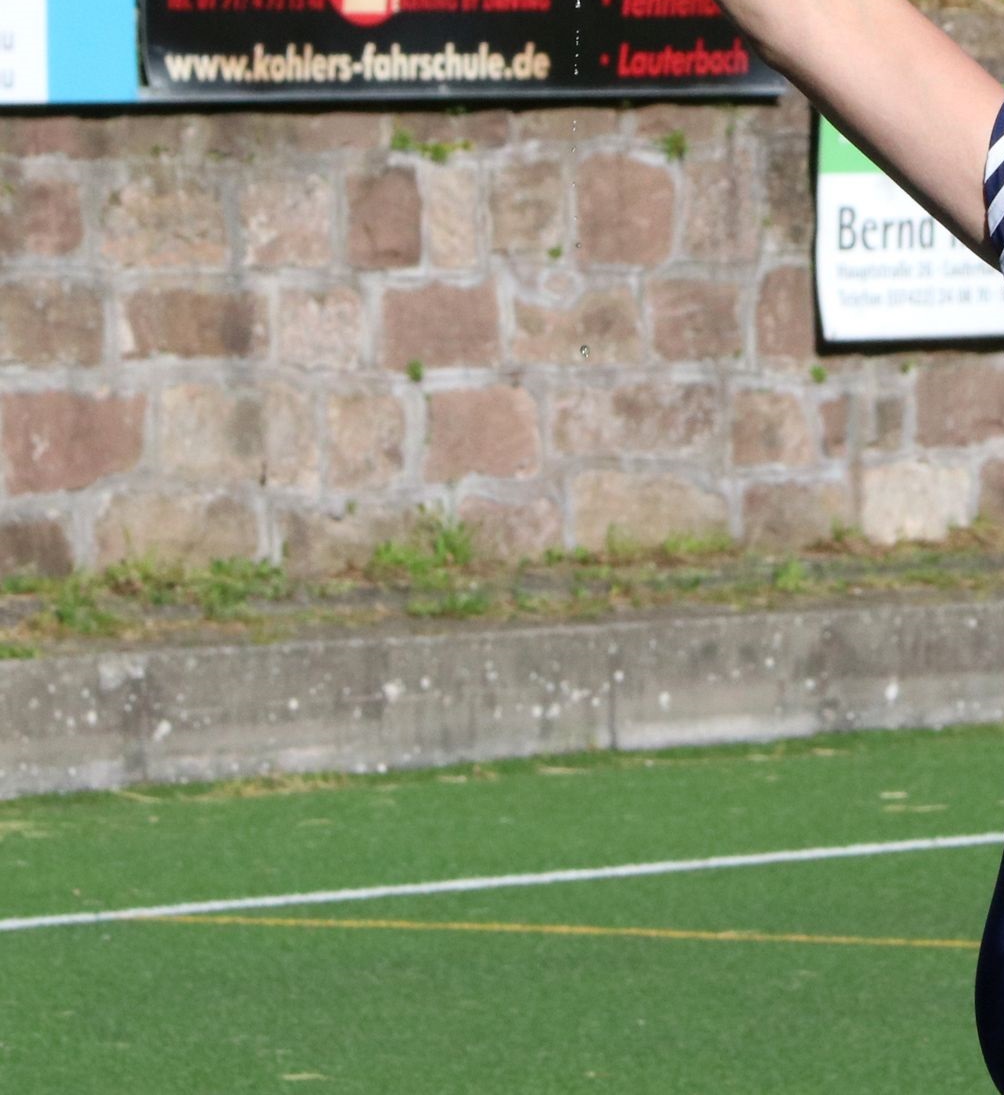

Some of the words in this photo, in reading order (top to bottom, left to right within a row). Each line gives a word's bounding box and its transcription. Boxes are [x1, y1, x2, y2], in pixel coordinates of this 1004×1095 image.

[163, 41, 551, 82] www.kohlers-fahrschule.de
[617, 38, 750, 78] Lauterbach
[837, 206, 935, 251] Bernd
